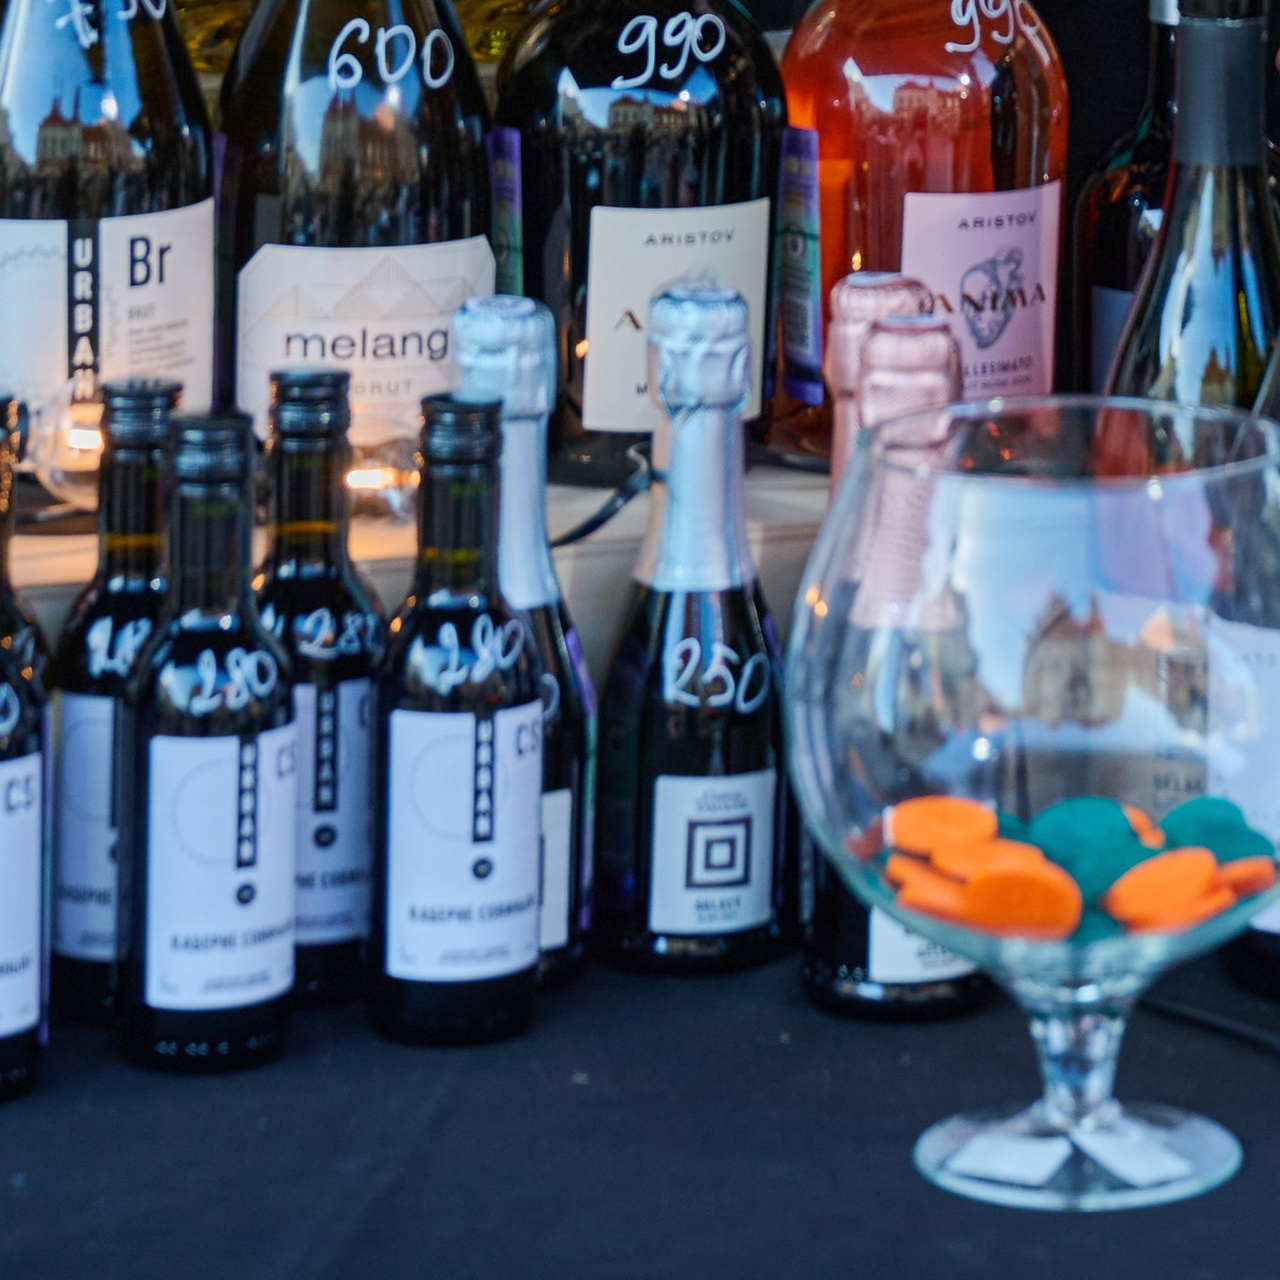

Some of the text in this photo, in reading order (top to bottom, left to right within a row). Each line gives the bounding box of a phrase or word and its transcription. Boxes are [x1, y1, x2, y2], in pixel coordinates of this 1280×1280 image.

[328, 17, 455, 92] 600
[611, 11, 726, 90] 990
[645, 229, 735, 247] ARISTOV
[958, 211, 1037, 230] ARISTOV
[129, 235, 172, 287] Br
[73, 238, 95, 400] URBAN
[190, 646, 278, 717] 280
[437, 612, 526, 696] 280
[666, 637, 771, 716] 250
